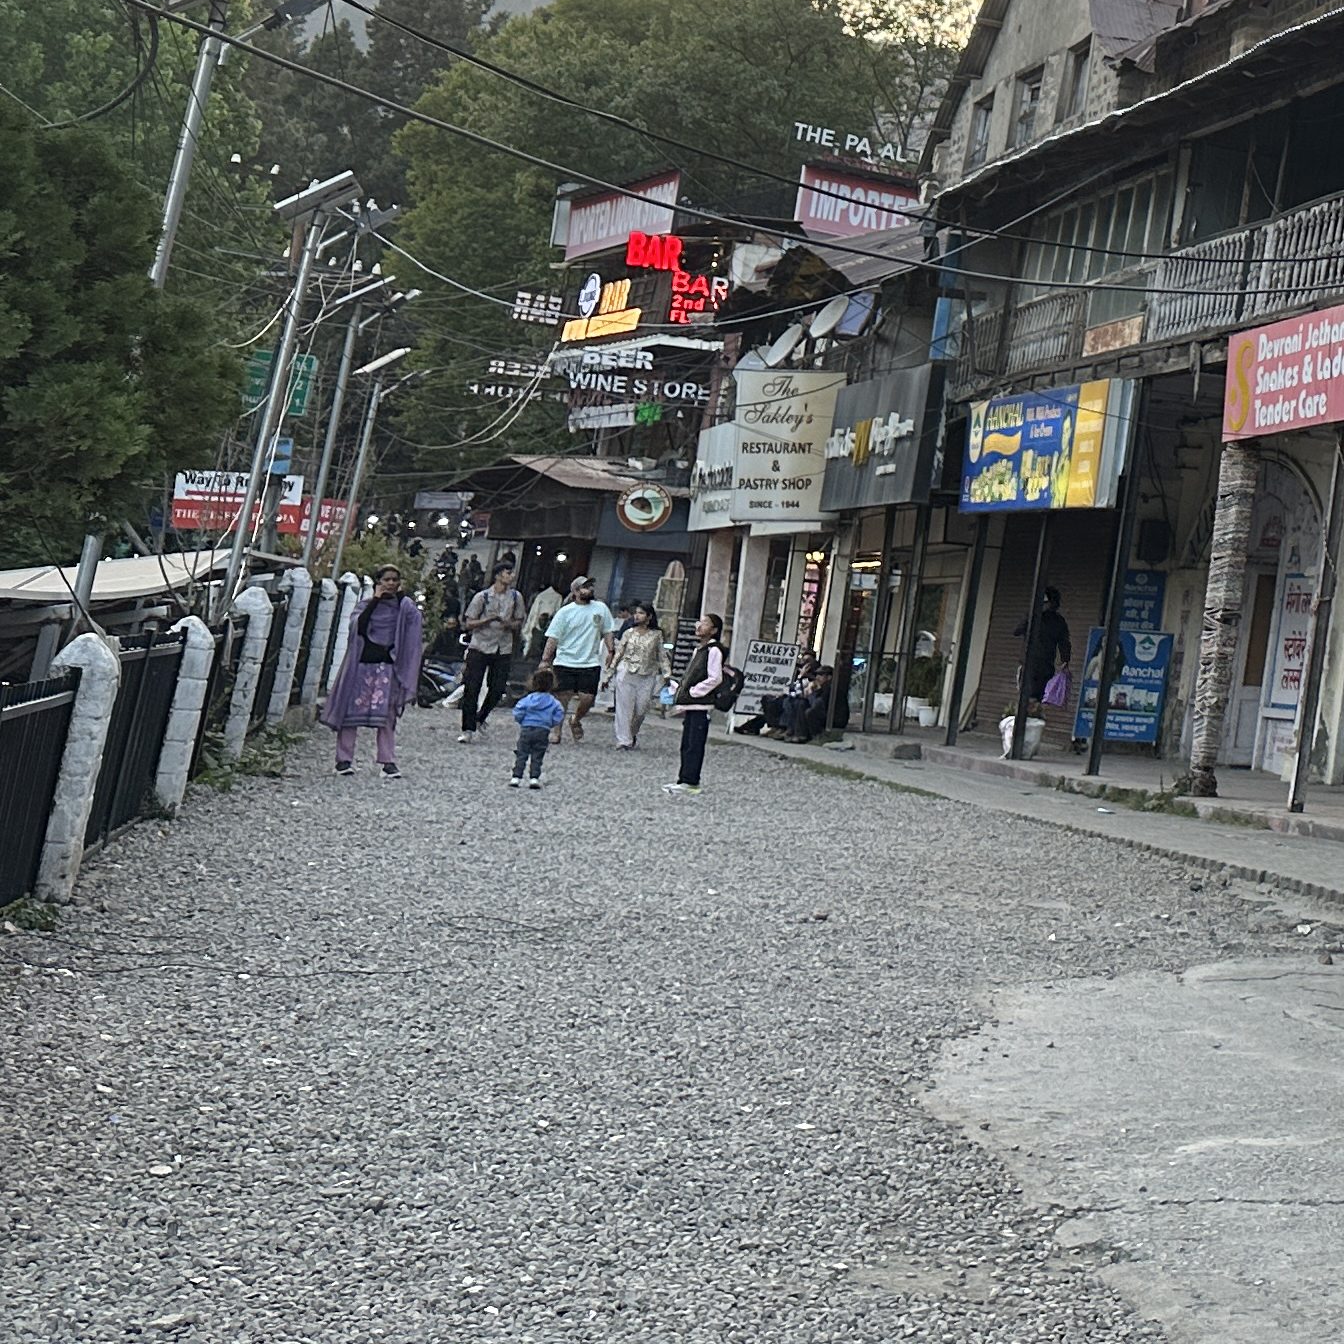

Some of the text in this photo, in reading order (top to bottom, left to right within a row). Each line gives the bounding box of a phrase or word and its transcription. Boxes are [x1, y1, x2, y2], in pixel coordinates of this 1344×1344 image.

[794, 122, 836, 147] THE
[626, 231, 683, 271] BAR
[672, 271, 729, 302] BAR
[671, 294, 706, 311] 2nd
[1257, 323, 1304, 362] Devrani
[583, 350, 654, 370] BEER
[1255, 360, 1299, 395] Snakes
[1302, 354, 1313, 384] &
[569, 371, 628, 394] WINE
[632, 379, 711, 402] STORE
[762, 375, 799, 399] The
[1254, 389, 1327, 429] Tender Care
[741, 442, 813, 455] RESTAURANT
[771, 459, 781, 472] &
[184, 472, 215, 487] Way
[738, 478, 812, 490] PASTRY SHOP
[749, 500, 773, 509] SINCE
[752, 643, 796, 658] SAKLEYS
[746, 654, 794, 667] RESTAURANT
[1122, 665, 1165, 679] Aanchal
